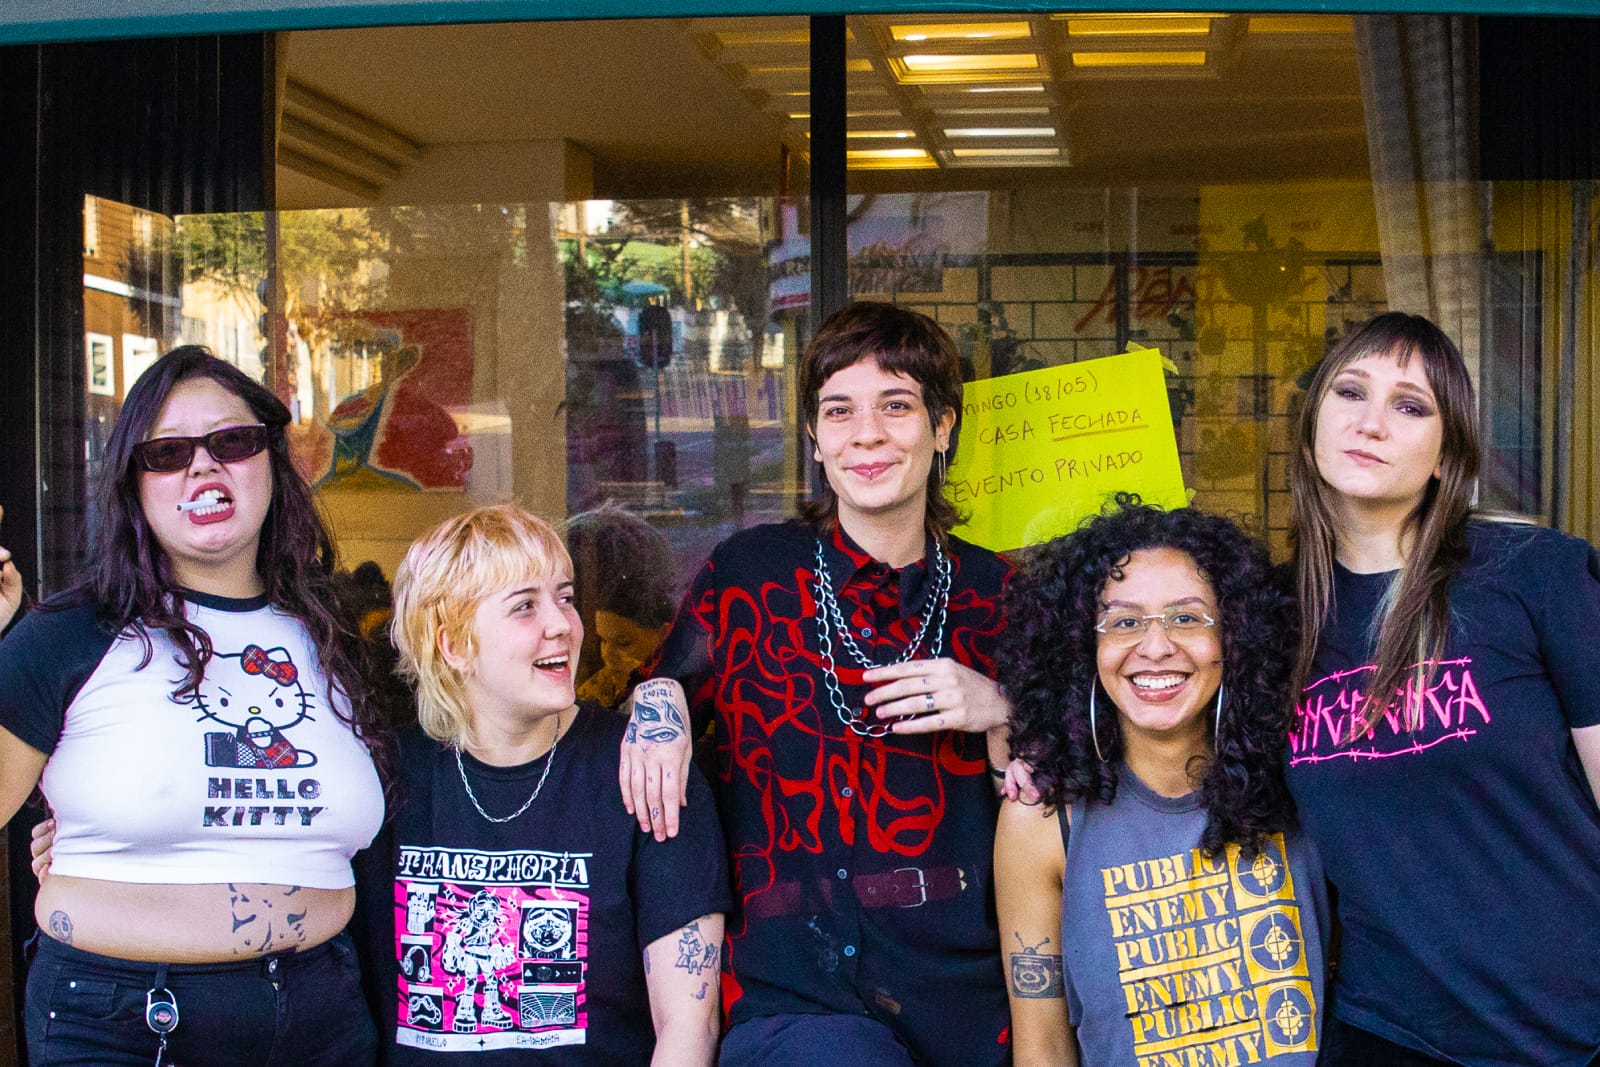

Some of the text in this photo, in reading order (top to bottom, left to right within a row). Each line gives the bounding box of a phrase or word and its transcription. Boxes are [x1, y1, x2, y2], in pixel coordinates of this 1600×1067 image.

[1024, 371, 1098, 405] (18/05)
[979, 408, 1143, 446] CASA FECHADA
[953, 450, 1143, 503] EVENTO PRIVADO
[207, 777, 321, 800] HELLO
[203, 806, 325, 827] KITTY
[399, 850, 589, 890] TRANSPHORIA
[1101, 847, 1226, 897] PUBLIC
[1106, 884, 1230, 938] ENEMY
[1114, 918, 1240, 972] PUBLIC
[1122, 959, 1245, 1014] ENEMY
[1130, 990, 1257, 1044] PUBLIC
